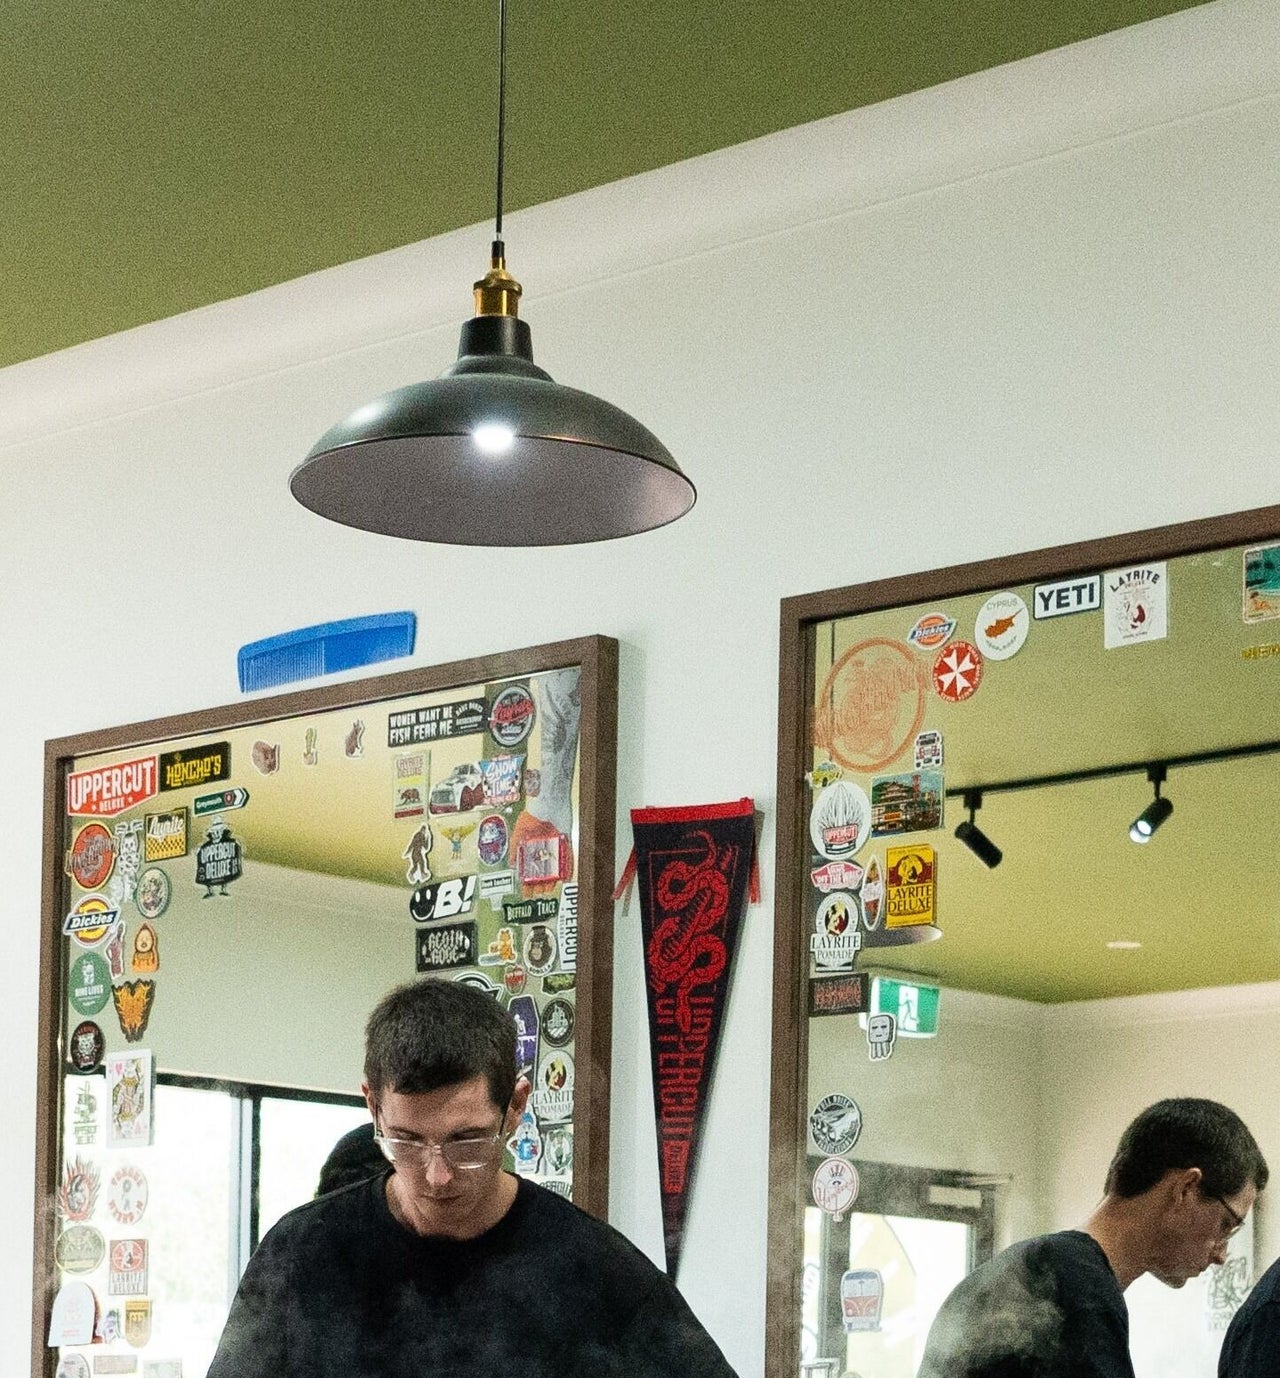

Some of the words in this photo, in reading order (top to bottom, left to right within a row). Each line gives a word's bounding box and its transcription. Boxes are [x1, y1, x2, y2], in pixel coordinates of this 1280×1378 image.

[1110, 570, 1160, 593] LAYRITE
[987, 599, 1018, 611] CYPRUS
[1039, 583, 1095, 611] YETI
[390, 712, 415, 728] WOMEN
[420, 708, 440, 724] WANT
[443, 706, 453, 720] ME
[390, 728, 410, 744] FISH
[414, 723, 436, 741] FEAR
[440, 720, 453, 736] ME
[166, 755, 222, 787] HONCHO'S
[71, 762, 154, 811] UPPERCUT
[201, 842, 236, 864] UPPERCUT
[206, 859, 233, 880] DELUXE
[888, 885, 932, 900] LAYRITE
[537, 901, 556, 916] TRACE
[888, 898, 931, 912] DELUXE
[70, 913, 114, 929] Dickies
[564, 886, 578, 964] UPPERCUT
[812, 935, 860, 949] LAYRITE
[817, 950, 852, 960] POMADE
[535, 1090, 572, 1104] LAYRIT
